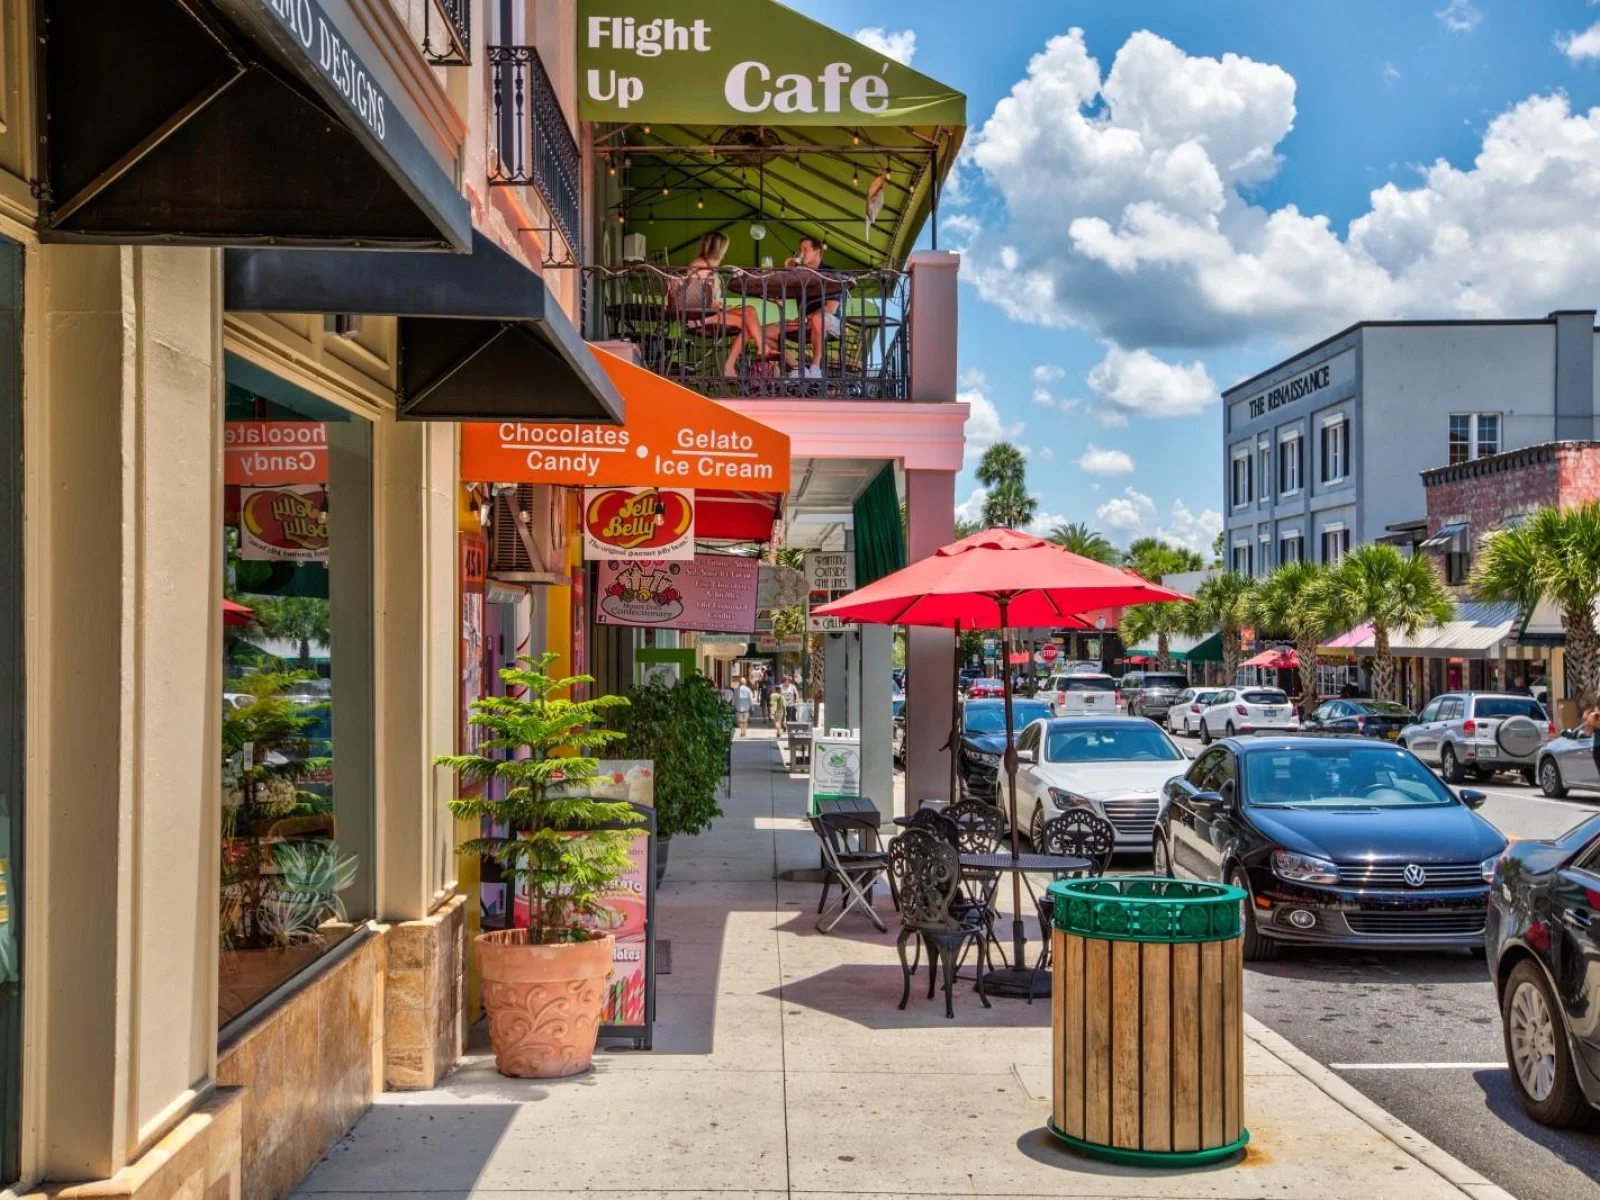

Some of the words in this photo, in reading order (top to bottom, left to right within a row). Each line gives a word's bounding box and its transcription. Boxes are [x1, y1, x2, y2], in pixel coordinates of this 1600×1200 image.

[587, 16, 712, 57] Flight
[319, 17, 385, 140] DESIGNS
[587, 69, 644, 109] Up
[724, 61, 890, 115] Café
[1248, 396, 1265, 420] THE
[1268, 365, 1330, 412] RENAISSANCE
[499, 422, 630, 445] Chocolates
[677, 428, 753, 450] Gelato
[526, 450, 601, 475] Candy
[655, 455, 689, 475] Ice
[697, 457, 773, 479] Cream
[602, 516, 656, 545] Belly
